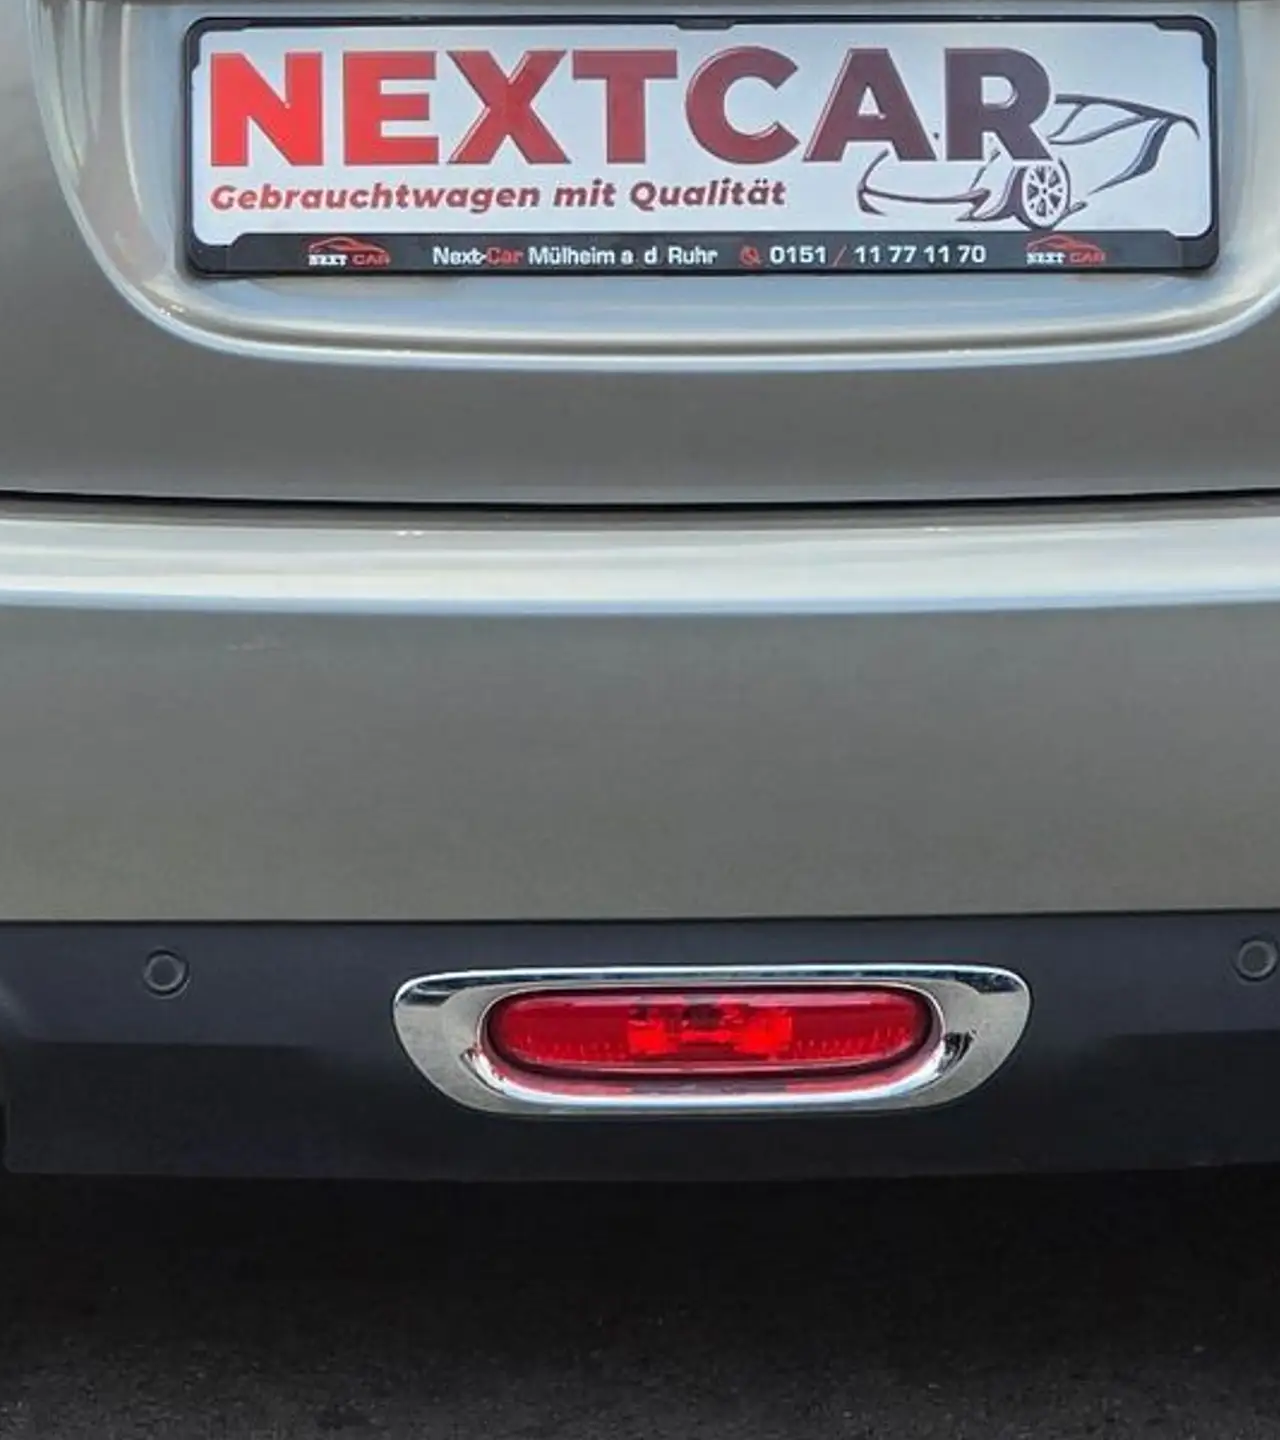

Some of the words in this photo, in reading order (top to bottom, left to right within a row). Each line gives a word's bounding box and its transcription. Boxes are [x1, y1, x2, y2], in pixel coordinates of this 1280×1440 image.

[210, 46, 1054, 168] NEXTCAR
[210, 182, 541, 214] Gebrauchtwagen
[553, 178, 617, 208] mit
[629, 179, 787, 212] Qualität
[528, 245, 616, 266] Mülheim
[668, 245, 718, 265] Ruhr
[770, 245, 827, 265] 0151
[854, 245, 881, 264] 11
[888, 245, 917, 264] 77
[923, 245, 950, 264] 11
[957, 245, 987, 264] 70
